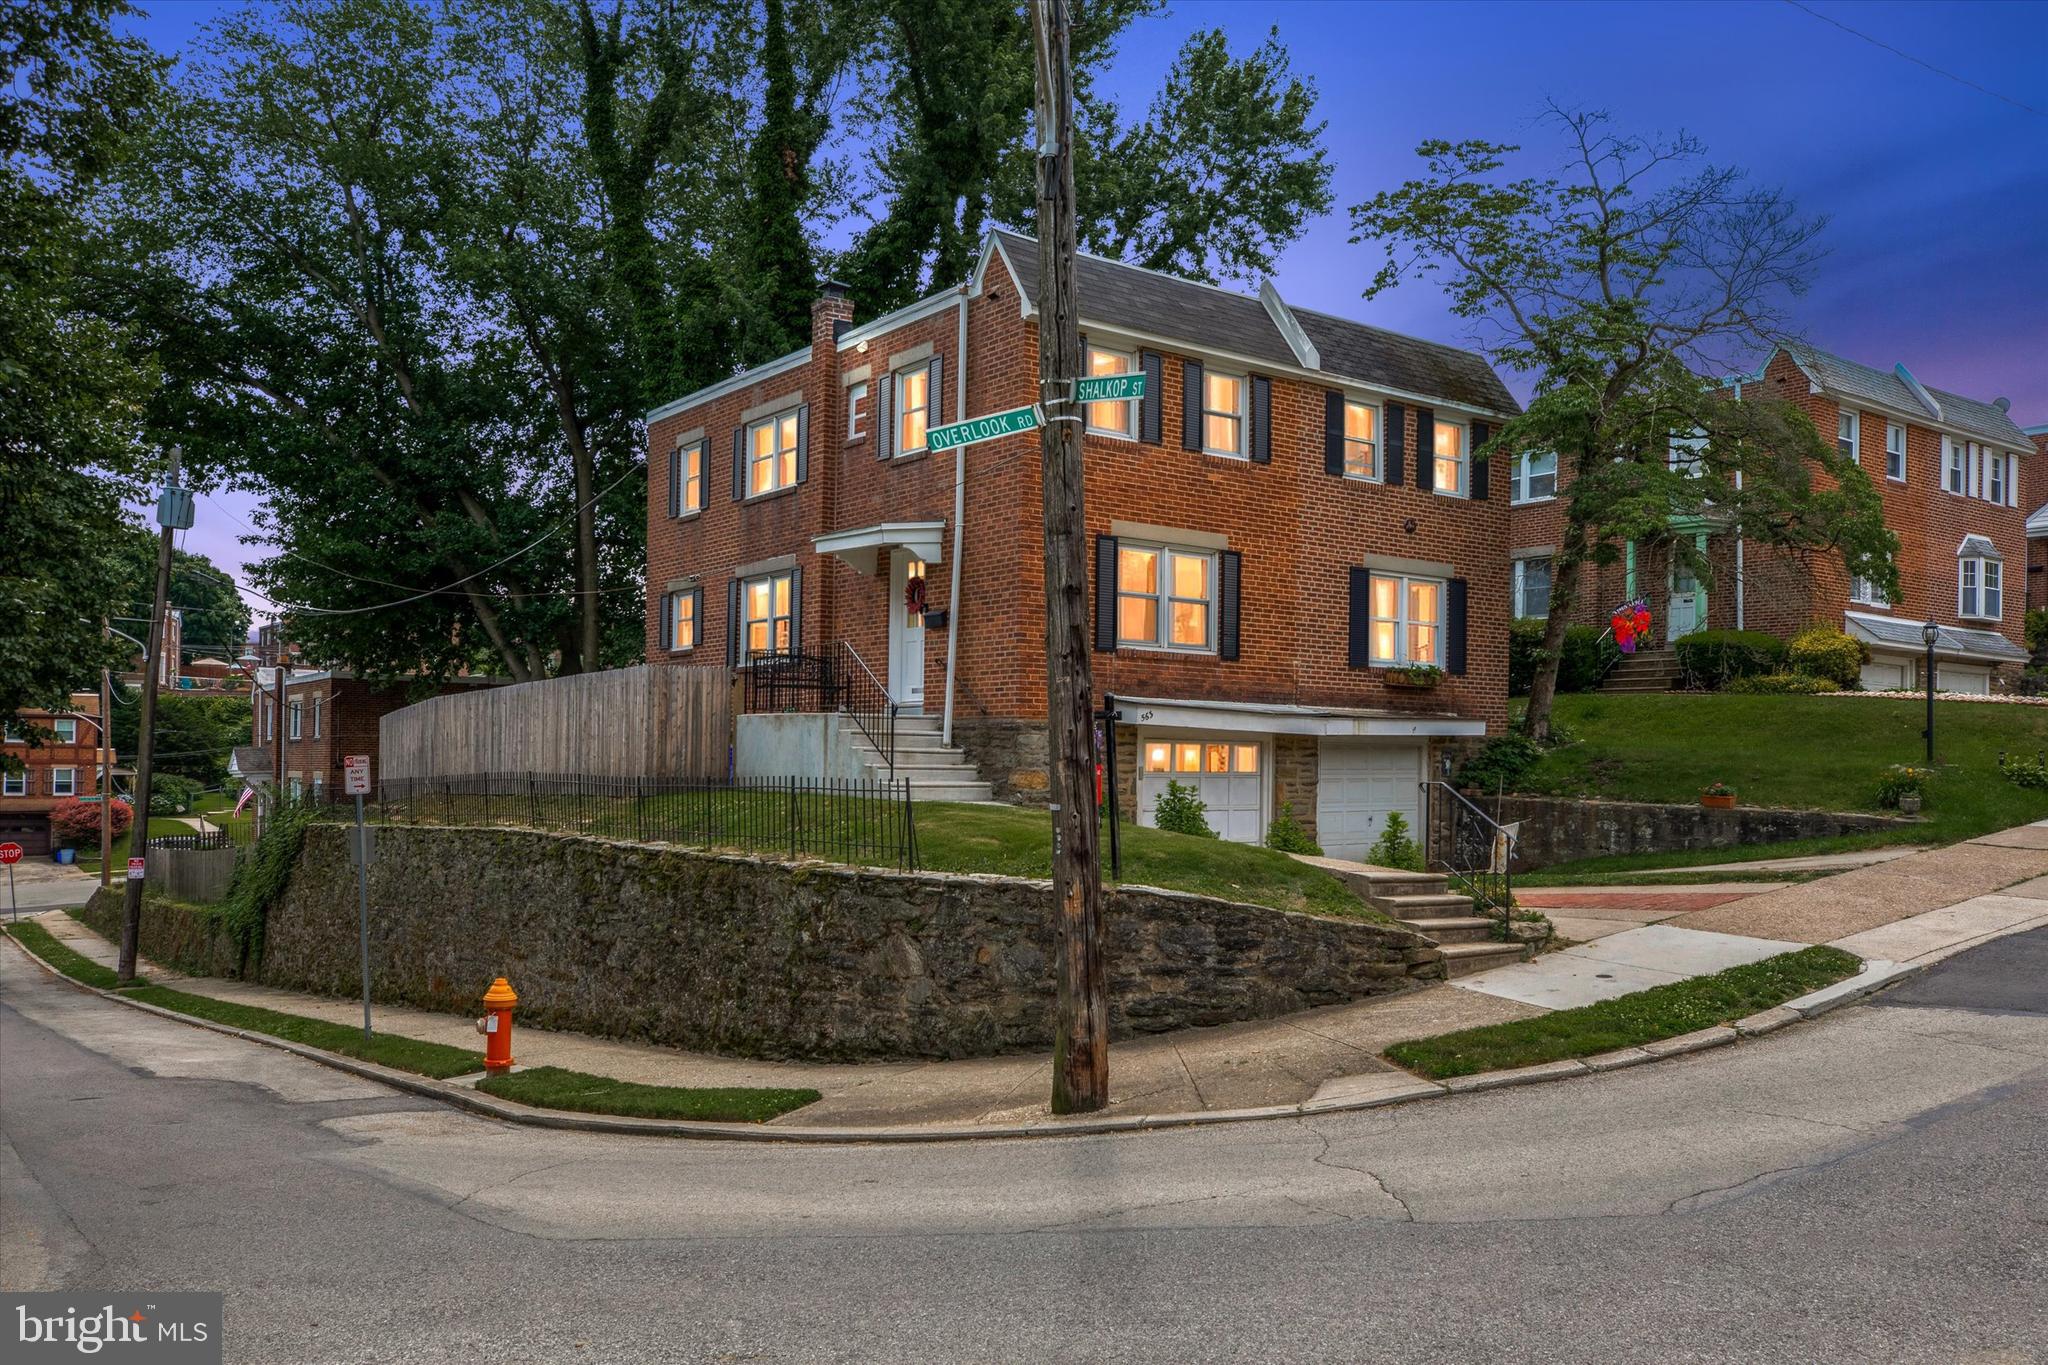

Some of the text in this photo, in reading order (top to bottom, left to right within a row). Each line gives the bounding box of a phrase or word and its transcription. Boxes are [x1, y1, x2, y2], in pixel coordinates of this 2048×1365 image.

[1079, 379, 1143, 400] SHALKOP ST
[932, 414, 1034, 449] OVERLOOK RD
[0, 849, 21, 858] STOP
